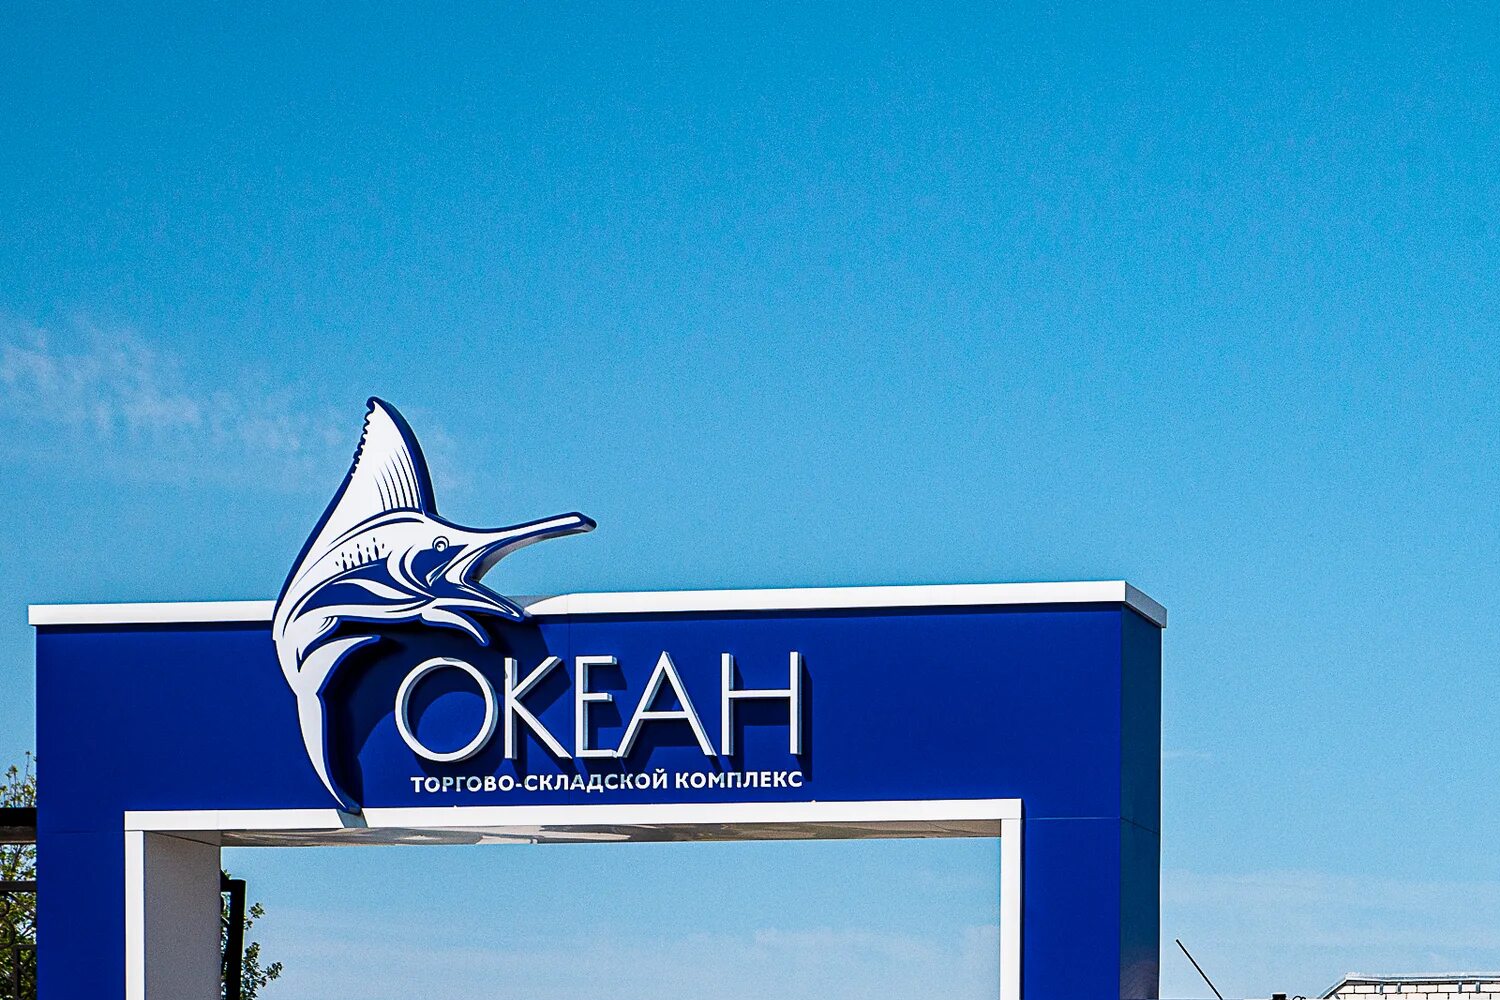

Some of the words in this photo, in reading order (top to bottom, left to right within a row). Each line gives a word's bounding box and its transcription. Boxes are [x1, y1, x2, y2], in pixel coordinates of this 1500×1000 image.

[394, 650, 801, 762] ОКЕАН
[410, 769, 668, 793] ТОРГОВО-СКЛАДСКОЙ
[675, 770, 803, 789] КОМПЛЕКС
